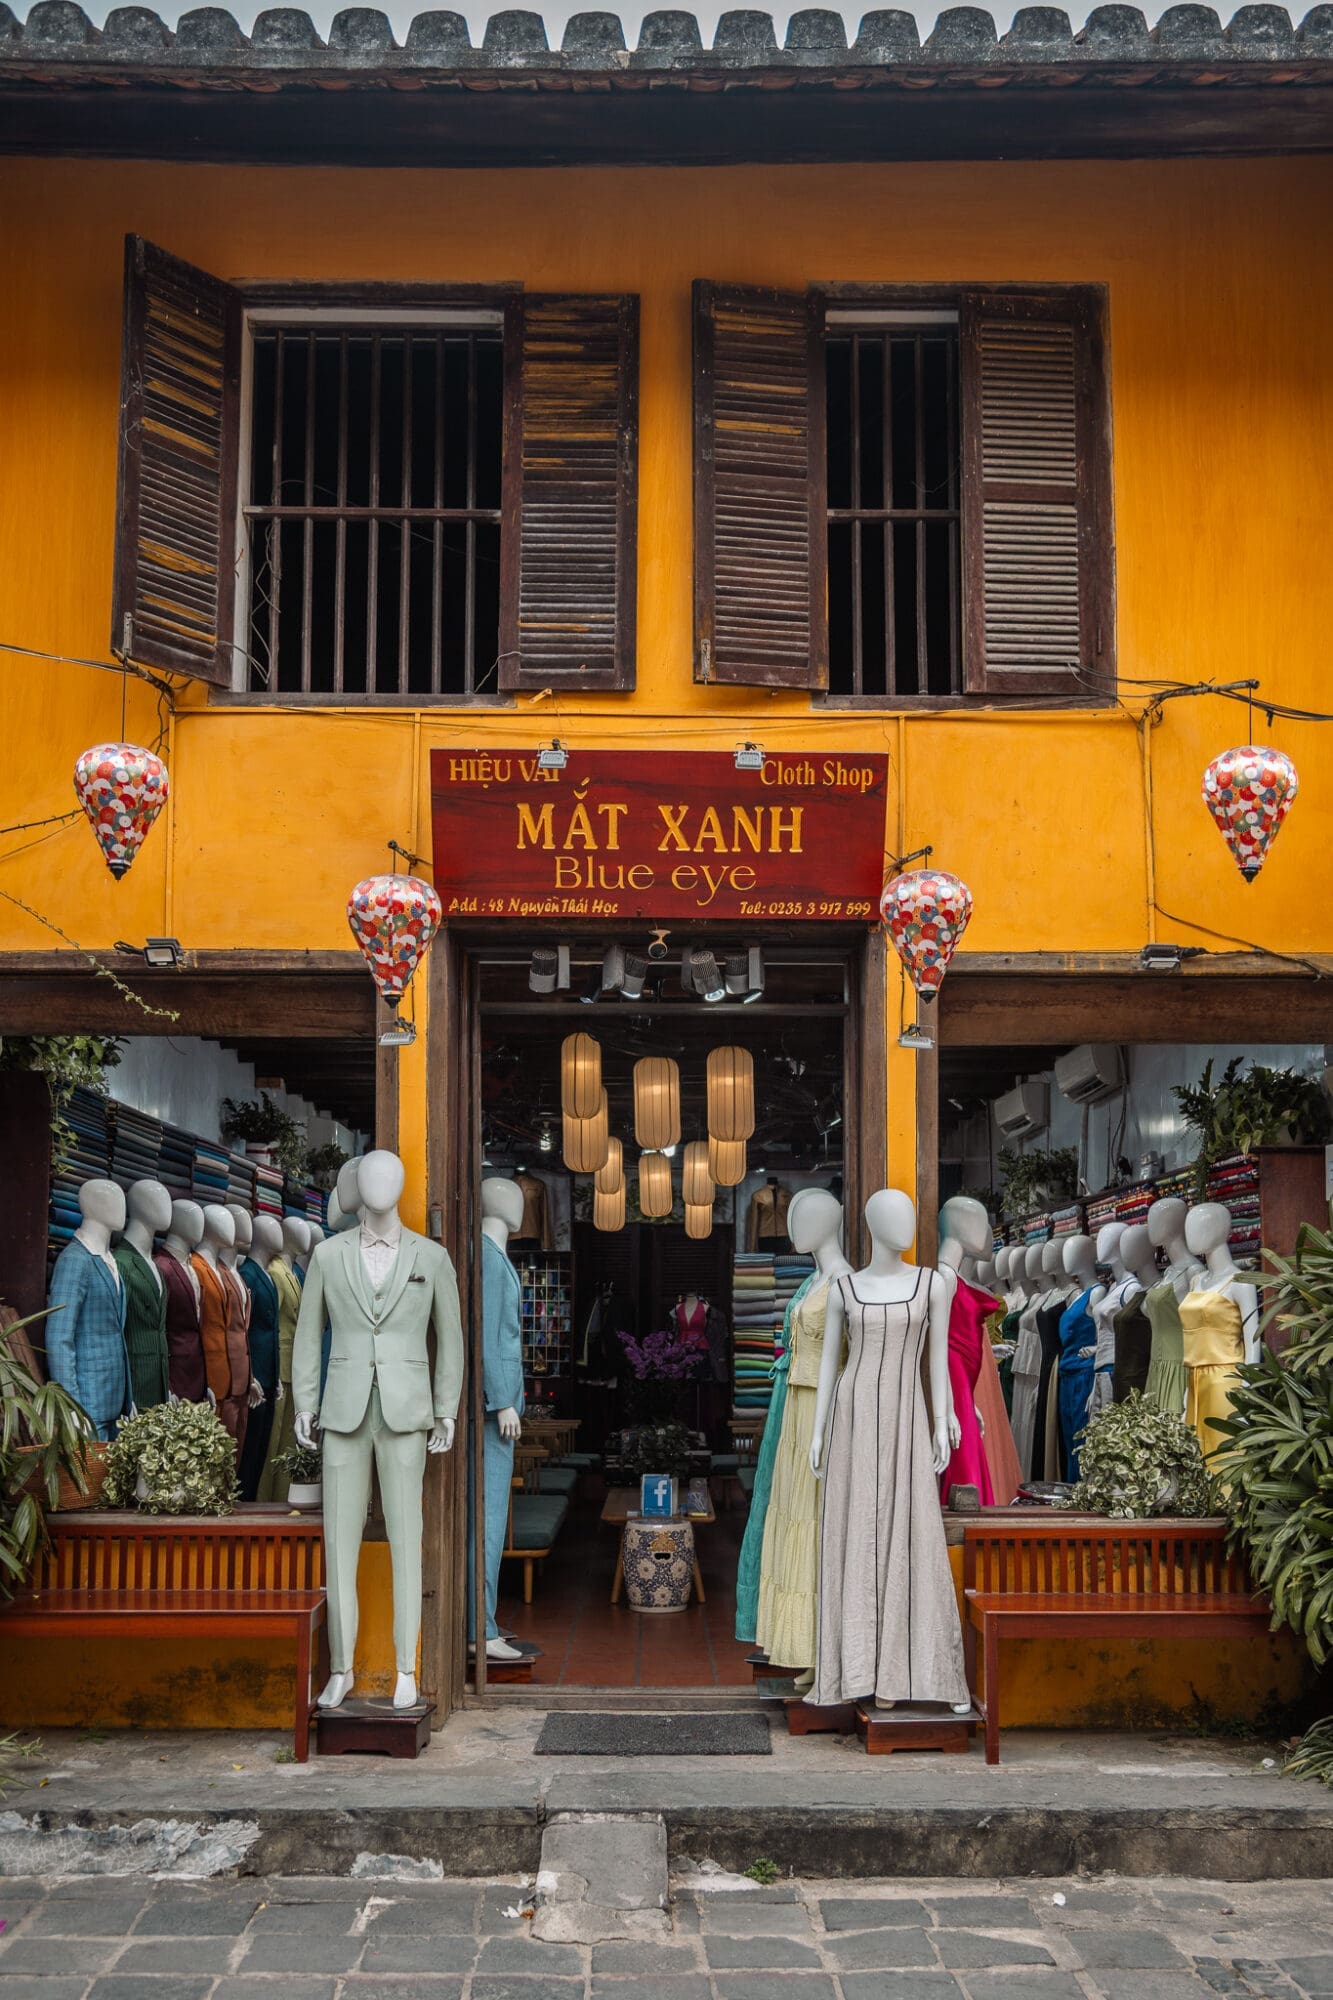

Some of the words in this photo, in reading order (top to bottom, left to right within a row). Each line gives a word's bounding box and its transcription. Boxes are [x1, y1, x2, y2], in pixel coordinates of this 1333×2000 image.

[449, 751, 511, 789] HIỆU
[760, 760, 816, 785] Cloth
[822, 760, 874, 793] Shop
[516, 776, 628, 850] MẮT
[657, 804, 804, 853] XANH
[554, 855, 655, 890] Blue
[671, 865, 757, 906] eye
[448, 897, 478, 912] Add
[488, 898, 504, 912] 48
[561, 898, 589, 914] Thái
[591, 899, 619, 917] Học
[740, 901, 767, 914] Tel:
[768, 902, 803, 915] 0235
[806, 902, 816, 915] 3
[819, 902, 842, 915] 917
[845, 902, 871, 916] 599
